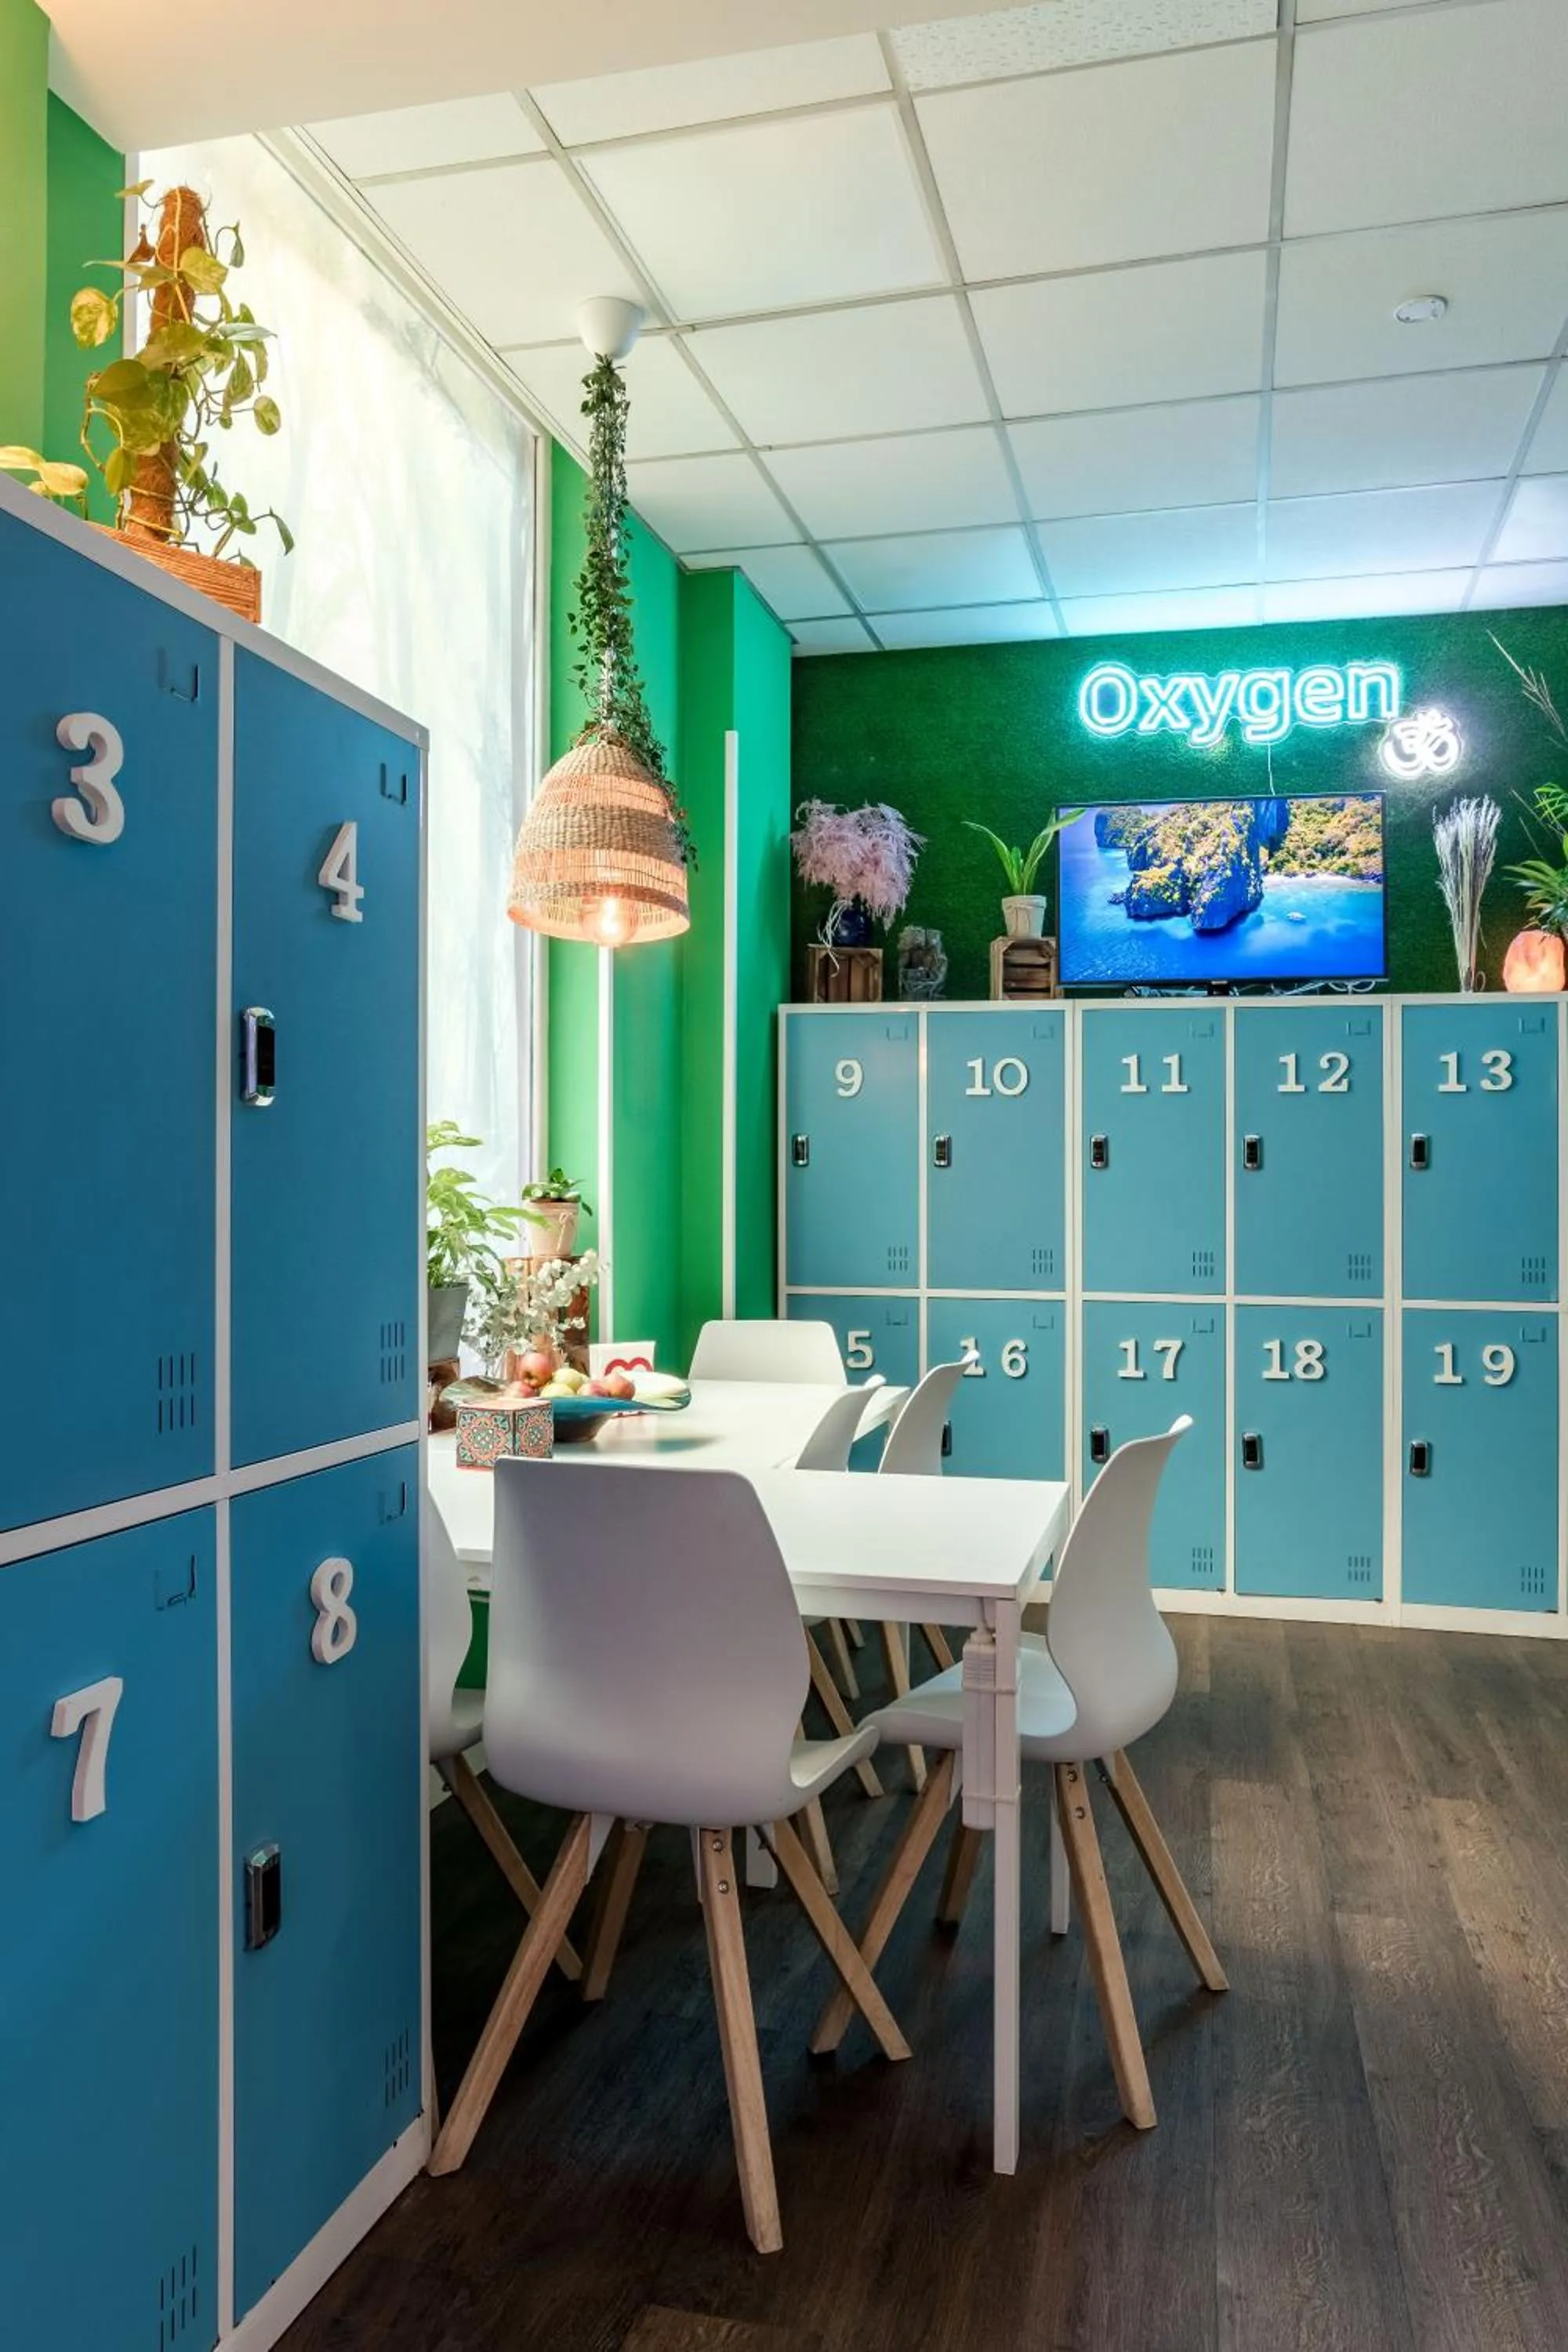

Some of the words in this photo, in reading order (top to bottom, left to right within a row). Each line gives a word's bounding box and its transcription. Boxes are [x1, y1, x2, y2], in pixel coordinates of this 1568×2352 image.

[1080, 663, 1399, 746] Oxygen
[51, 712, 125, 844] 3
[318, 821, 365, 923] 4
[834, 1058, 863, 1098] 9
[965, 1056, 1029, 1097] 10
[1120, 1053, 1189, 1093] 11
[1278, 1051, 1349, 1092] 12
[1438, 1050, 1512, 1092] 13
[846, 1330, 873, 1368] 5
[1116, 1338, 1184, 1380] 17
[1261, 1338, 1325, 1380] 18
[1433, 1342, 1515, 1386] 19
[310, 1557, 358, 1664] 8
[50, 1676, 123, 1822] 7
